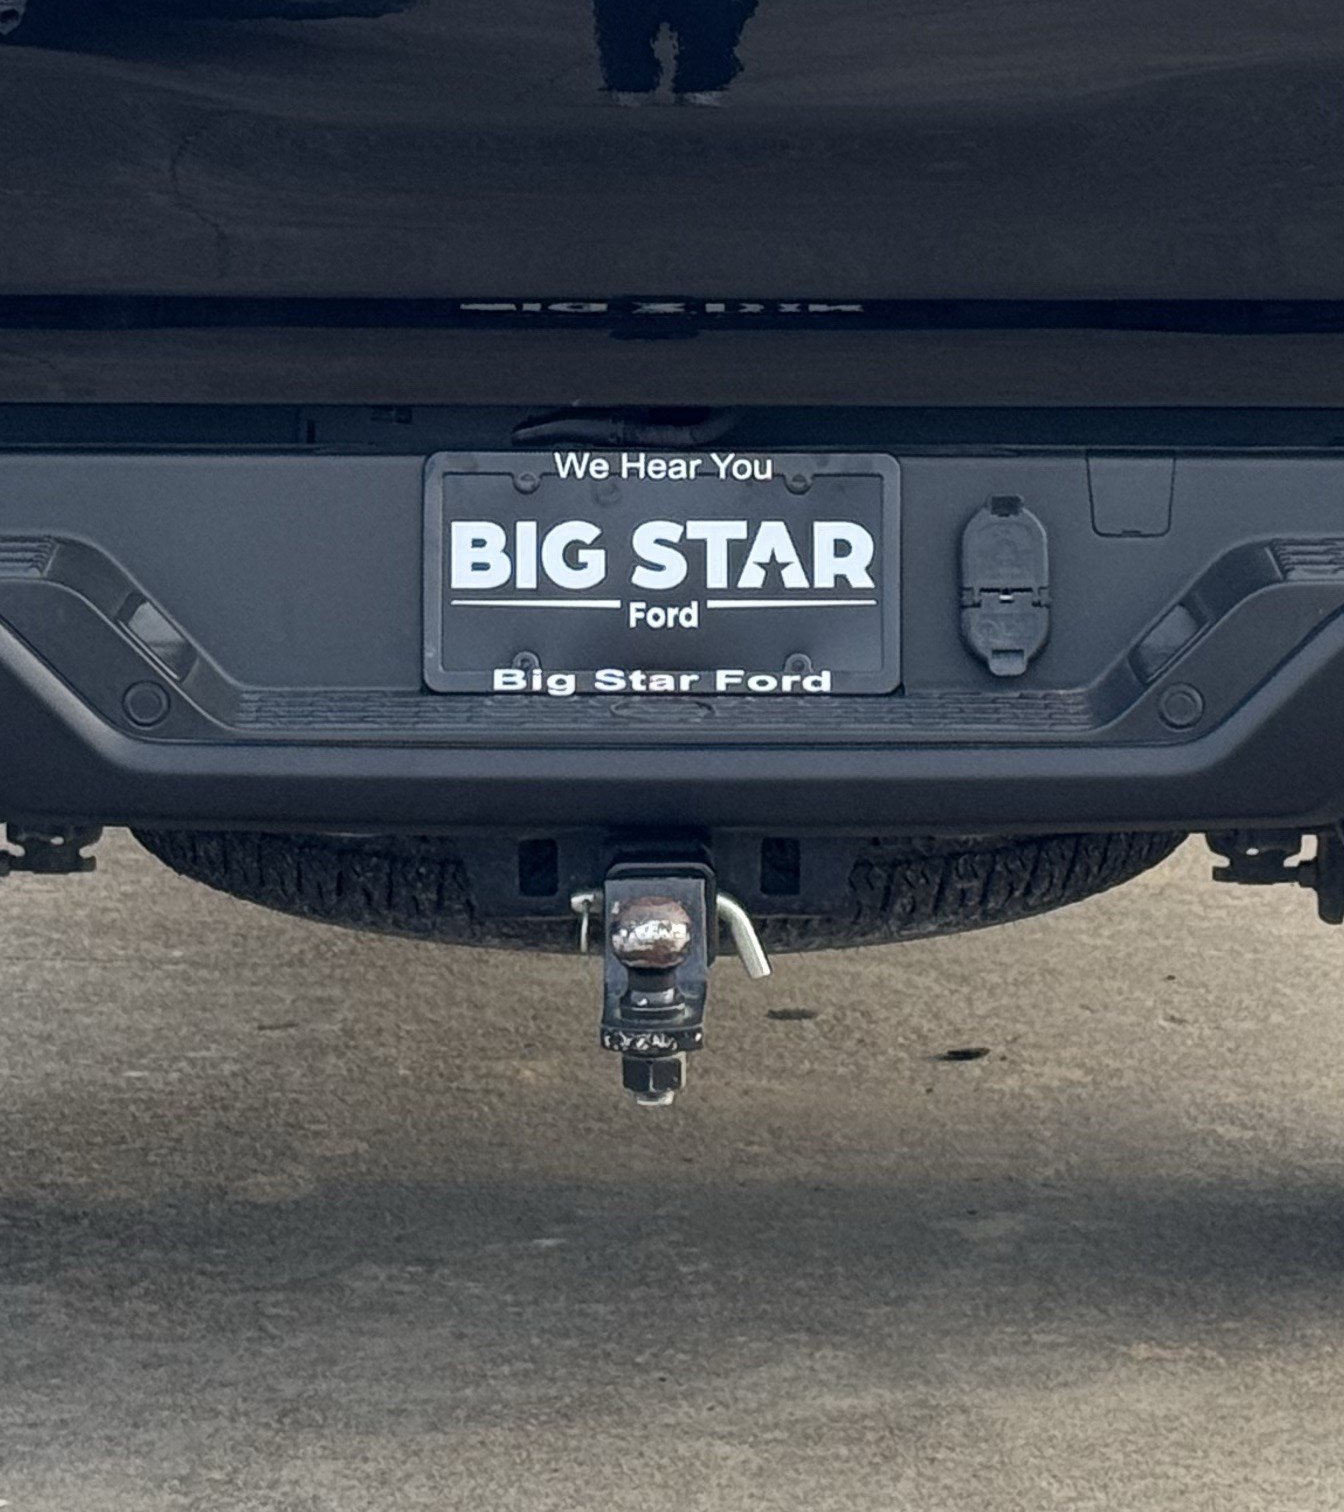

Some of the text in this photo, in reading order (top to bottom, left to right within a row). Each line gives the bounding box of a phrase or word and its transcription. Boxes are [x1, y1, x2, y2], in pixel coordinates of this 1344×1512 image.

[553, 452, 772, 480] We Hear You
[450, 520, 876, 590] BIG STAR
[629, 600, 699, 628] Ford
[493, 668, 832, 696] Big Star Ford
